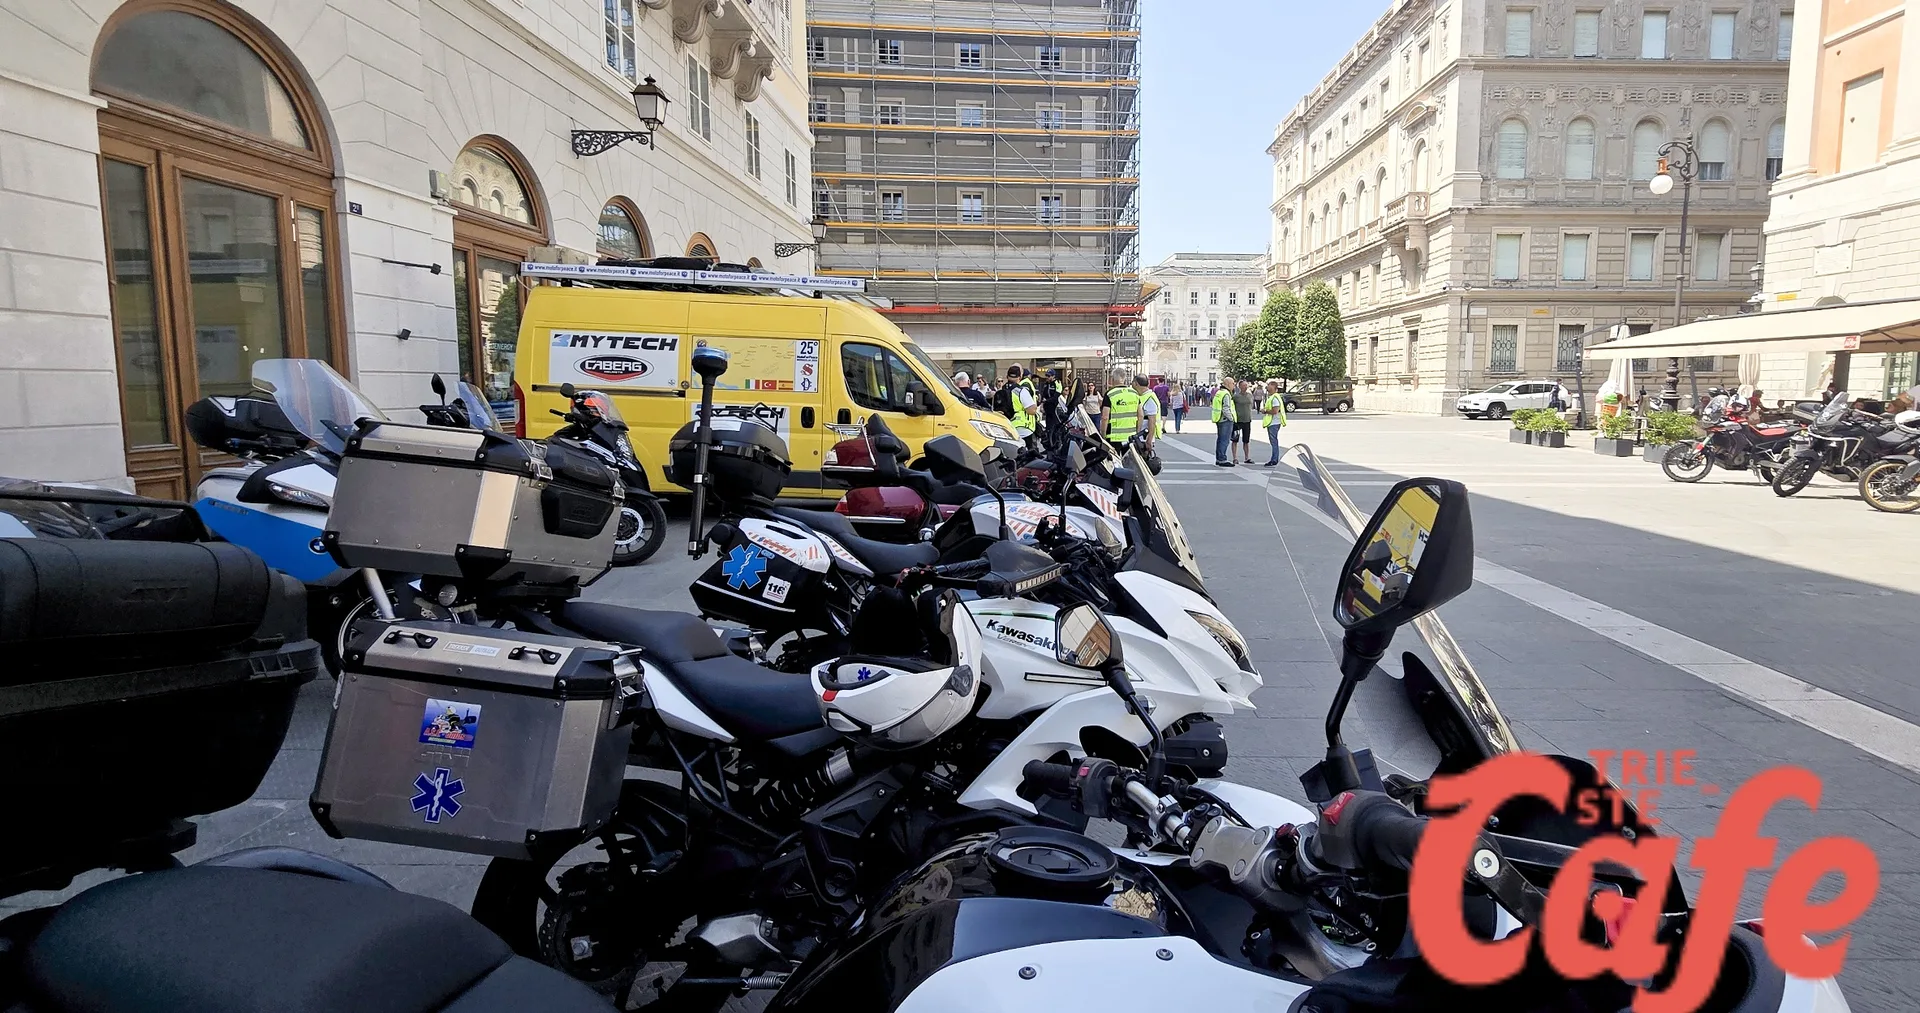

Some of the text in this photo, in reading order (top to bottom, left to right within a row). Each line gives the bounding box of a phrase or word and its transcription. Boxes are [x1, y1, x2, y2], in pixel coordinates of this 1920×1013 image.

[569, 334, 678, 351] MYTECH
[584, 360, 643, 372] CABERG
[986, 619, 1057, 651] Kawasaki
